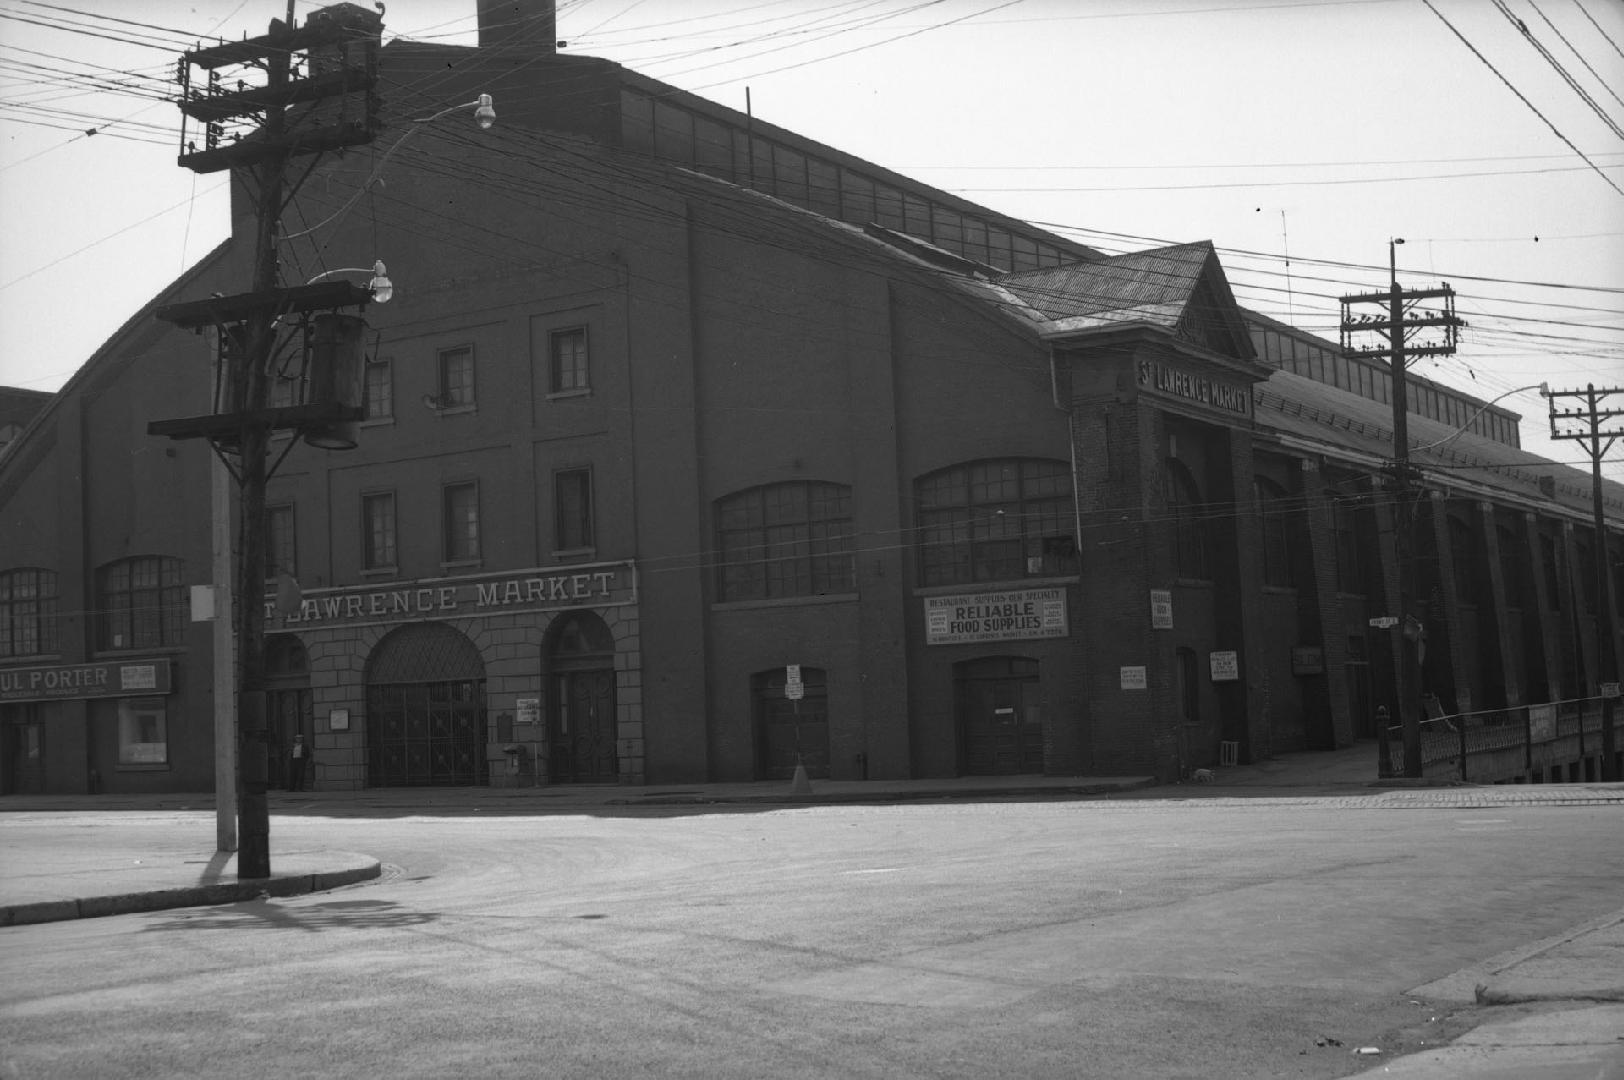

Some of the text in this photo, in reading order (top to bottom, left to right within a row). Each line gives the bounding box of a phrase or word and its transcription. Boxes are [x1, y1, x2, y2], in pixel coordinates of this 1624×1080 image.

[1154, 361, 1209, 403] LAWRENCE
[1209, 383, 1247, 414] MARKET
[476, 572, 615, 606] MARKET
[956, 602, 1035, 620] RELIABLE
[950, 620, 980, 634] FOOD
[983, 616, 1041, 632] SUPPLIES
[0, 672, 23, 691] UL
[30, 668, 108, 689] PORTER
